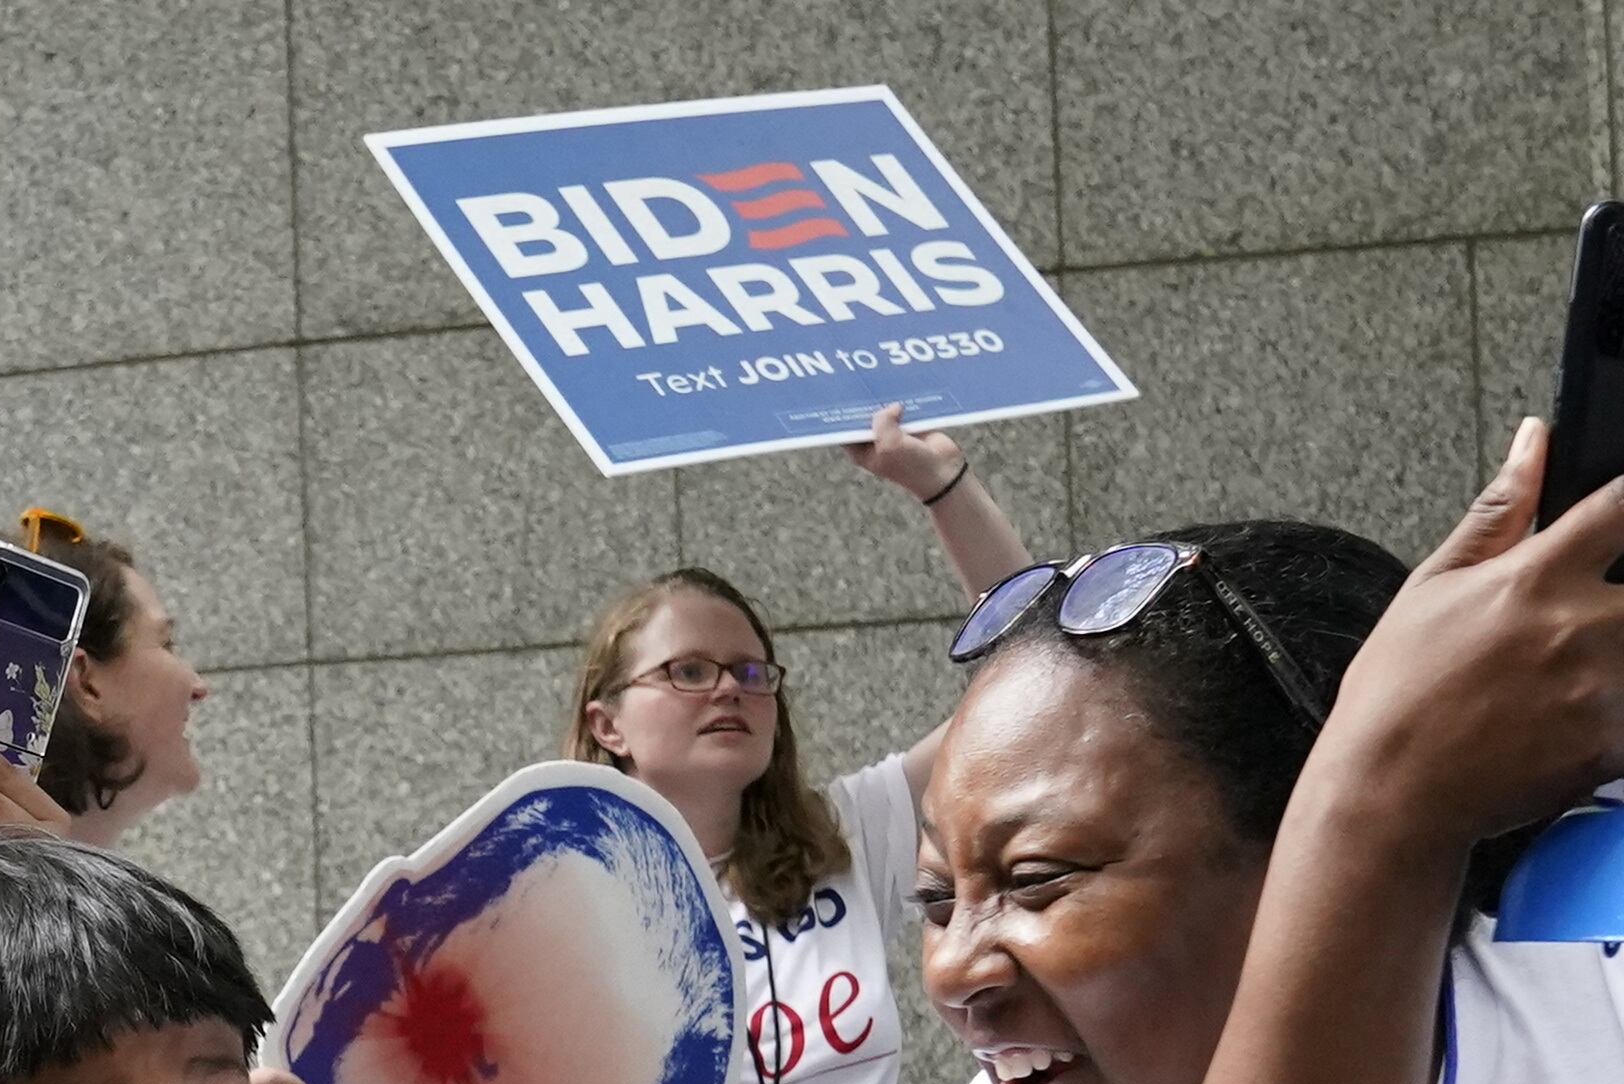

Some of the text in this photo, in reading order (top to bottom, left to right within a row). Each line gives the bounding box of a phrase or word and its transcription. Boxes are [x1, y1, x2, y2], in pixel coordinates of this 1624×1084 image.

[455, 153, 949, 279] BIDEN
[522, 240, 1005, 357] HARRIS
[636, 329, 1005, 397] Text JOIN to 30330
[1244, 618, 1280, 663] HOPE
[749, 971, 873, 1079] oe
